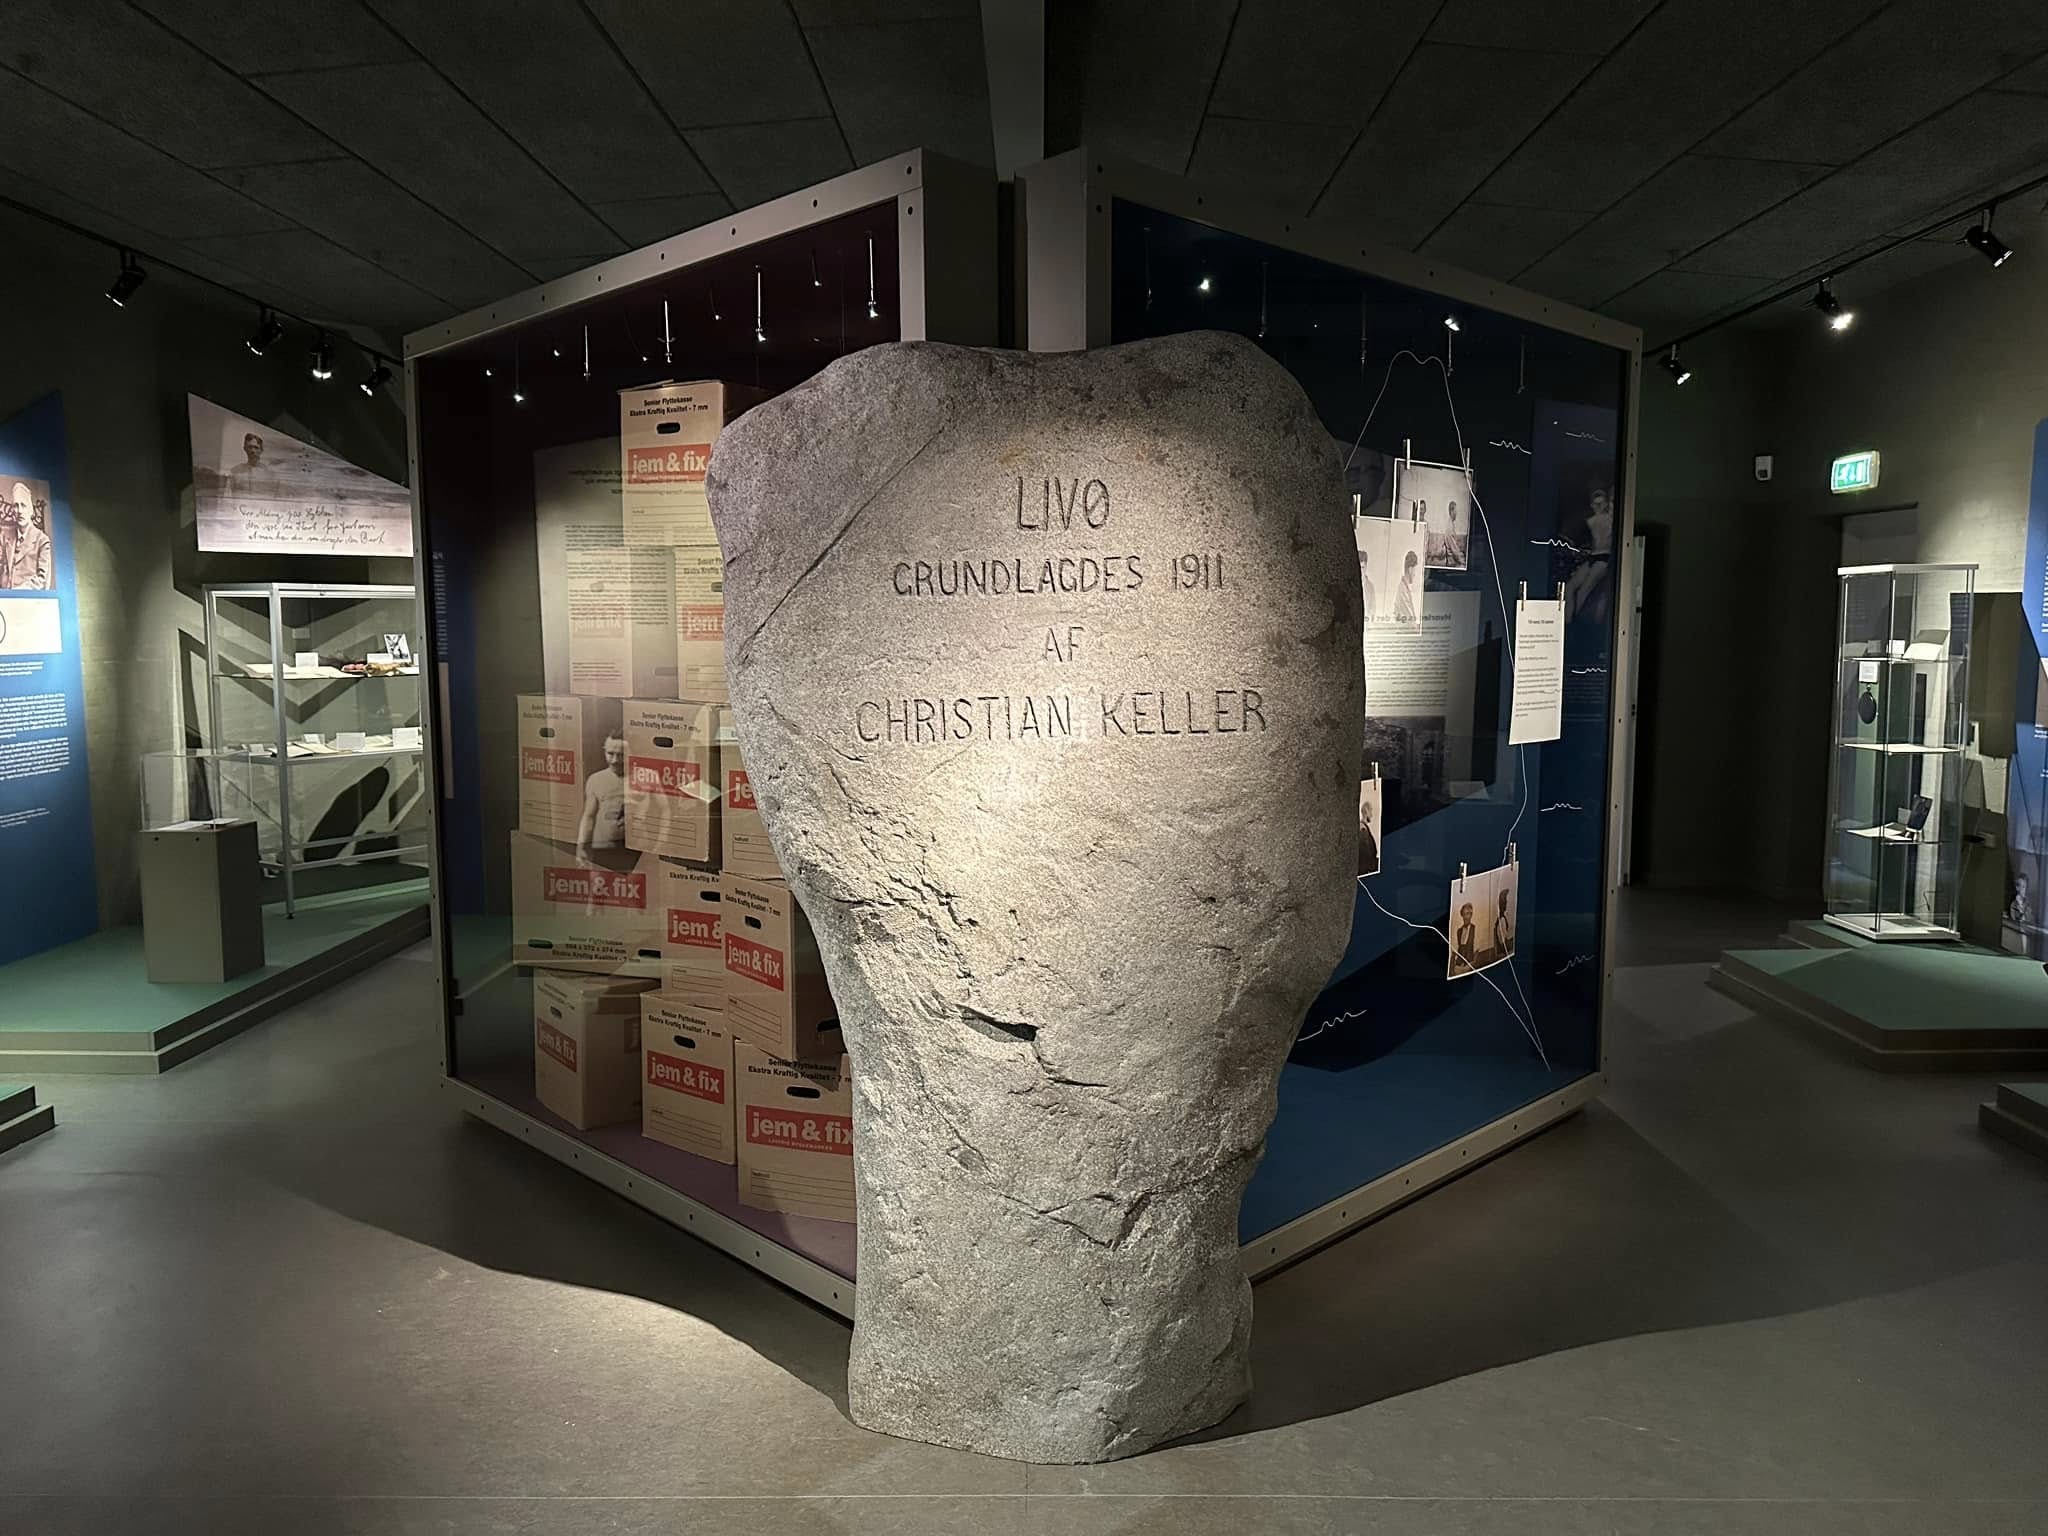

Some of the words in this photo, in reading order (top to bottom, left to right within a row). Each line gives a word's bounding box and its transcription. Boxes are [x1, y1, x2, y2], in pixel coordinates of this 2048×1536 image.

[647, 407, 665, 416] Kraftig
[632, 454, 664, 479] jem
[666, 452, 680, 472] &
[683, 451, 706, 472] fix
[1016, 476, 1110, 531] LIVØ
[892, 554, 1144, 597] GRUNDLAGDES
[1171, 553, 1226, 590] 1911
[1043, 626, 1085, 662] AF
[856, 693, 1072, 743] CHRISTIAN
[1100, 687, 1268, 738] KELLER
[524, 752, 545, 775] jem
[546, 754, 556, 773] &
[556, 755, 572, 776] fix
[631, 762, 660, 786] jem
[662, 766, 674, 786] &
[734, 776, 754, 802] je
[549, 872, 588, 897] jem
[592, 876, 610, 897] &
[613, 877, 641, 899] fix
[672, 914, 709, 938] jem
[728, 940, 750, 968] jem
[752, 950, 762, 973] &
[764, 953, 781, 979] fix
[650, 1056, 680, 1084] jem
[683, 1066, 697, 1088] &
[698, 1070, 720, 1094] fix
[748, 1065, 772, 1075] Ekstra
[773, 1068, 799, 1078] Kraftig
[800, 1071, 830, 1081] Kvalitet
[768, 1058, 792, 1067] Senior
[752, 1111, 797, 1138] jem
[801, 1119, 822, 1142] &
[825, 1120, 853, 1145] fix
